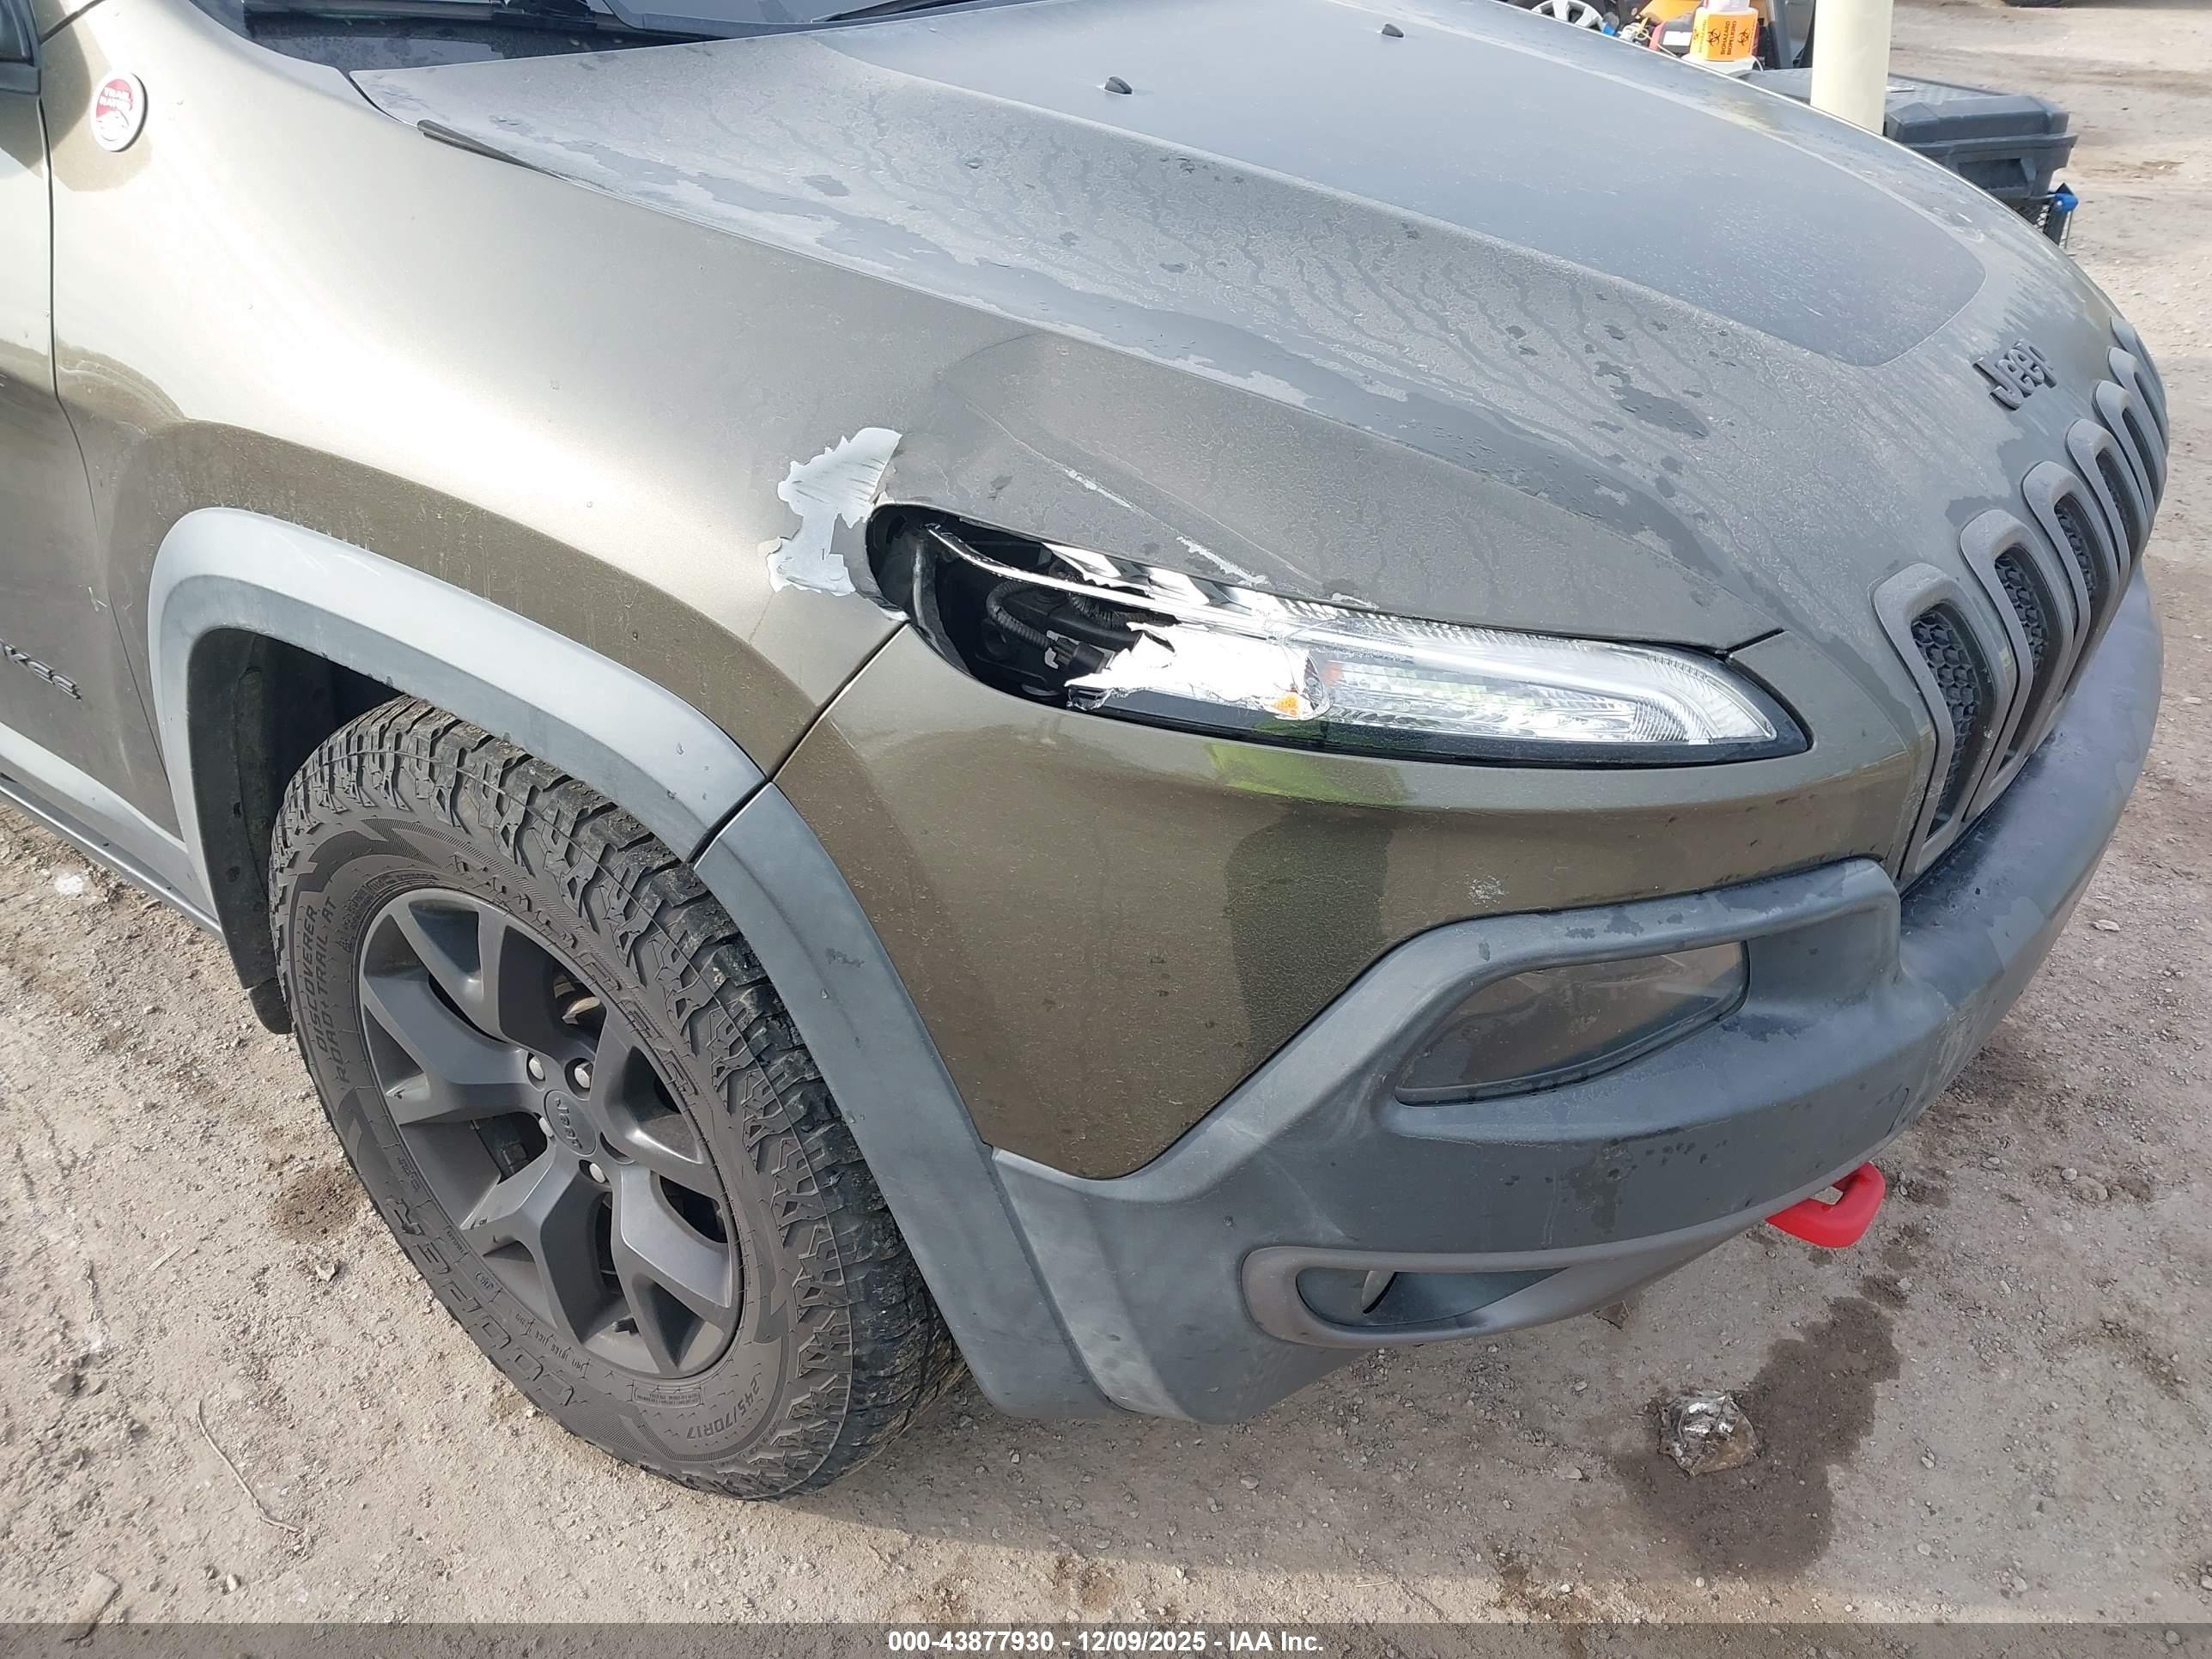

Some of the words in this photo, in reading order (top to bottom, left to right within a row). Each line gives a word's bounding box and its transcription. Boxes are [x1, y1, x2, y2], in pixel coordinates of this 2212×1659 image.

[1720, 21, 1731, 56] BIOHAZARD
[1972, 339, 2057, 411] Jeep
[321, 896, 337, 924] AT
[302, 904, 328, 1053] DISCOVERER
[555, 1098, 583, 1150] Jeep
[687, 1376, 760, 1440] 245/70R17
